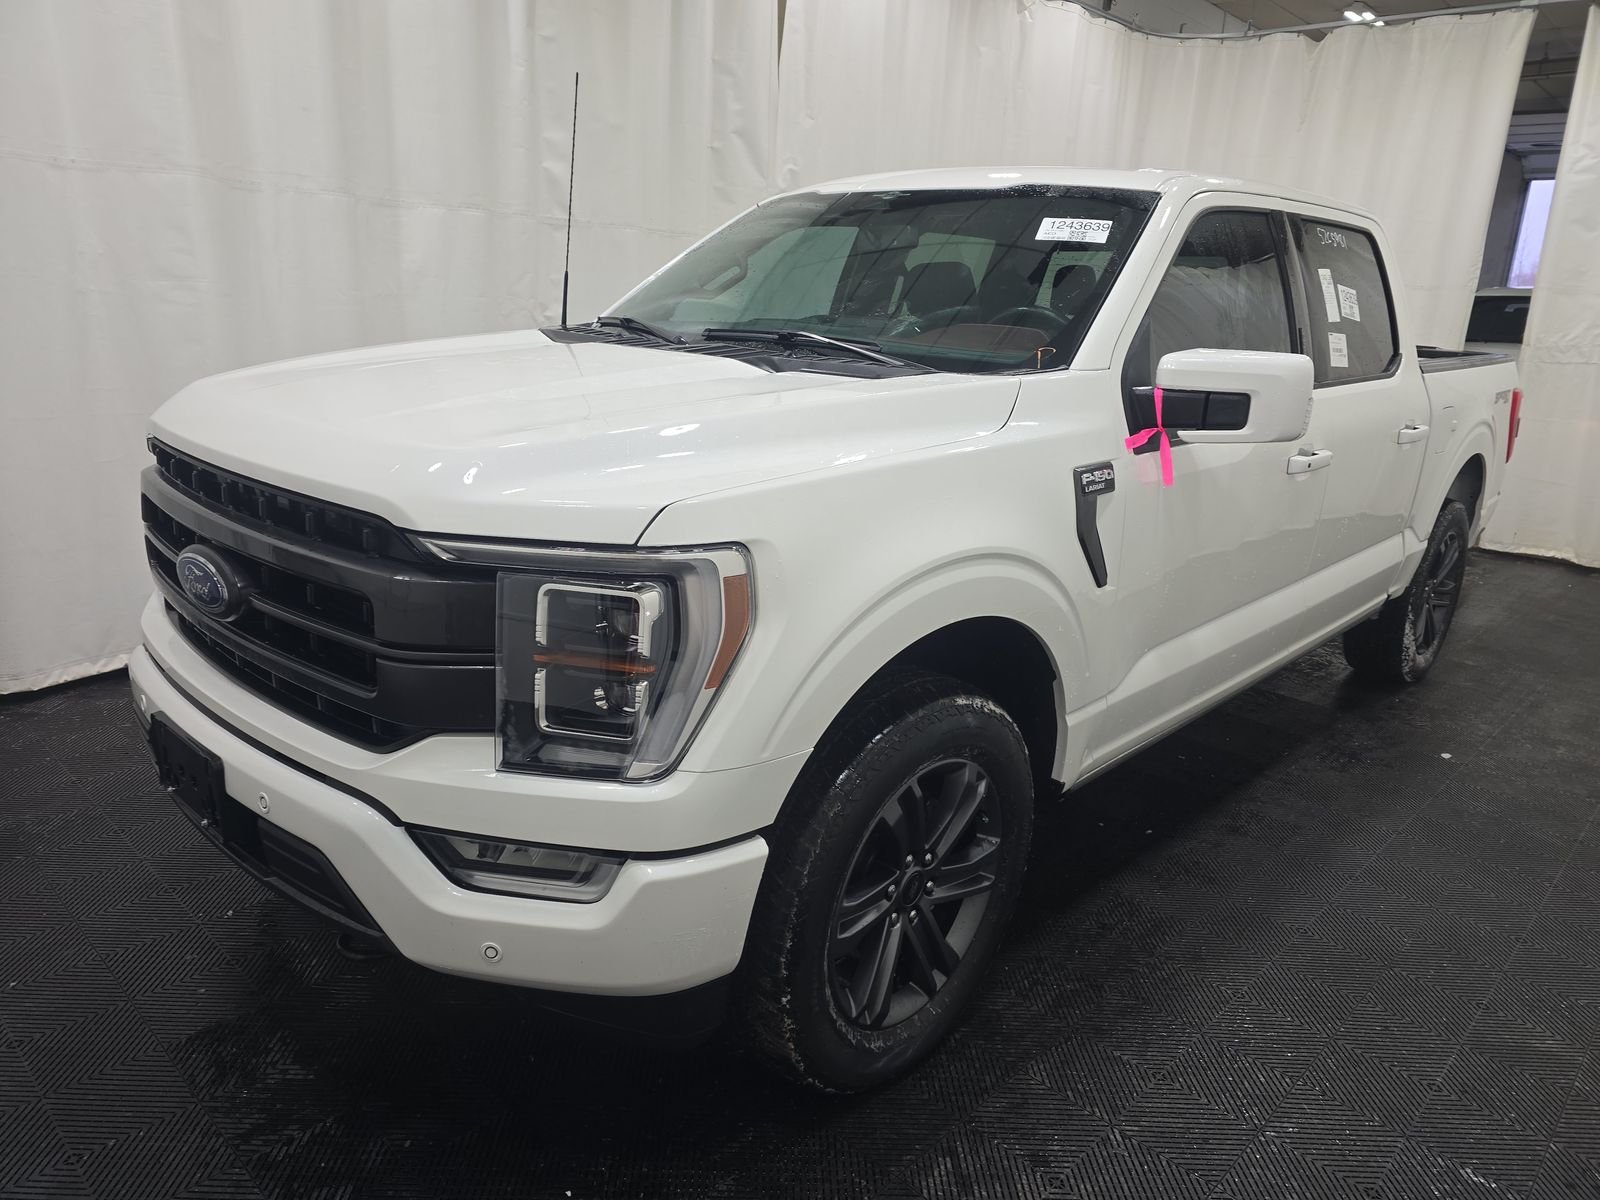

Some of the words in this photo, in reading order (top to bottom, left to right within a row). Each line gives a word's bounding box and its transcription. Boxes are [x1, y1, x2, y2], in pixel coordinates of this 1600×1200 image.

[1050, 220, 1111, 232] 1243639
[1085, 482, 1106, 493] LARIAT
[183, 564, 212, 601] Ford
